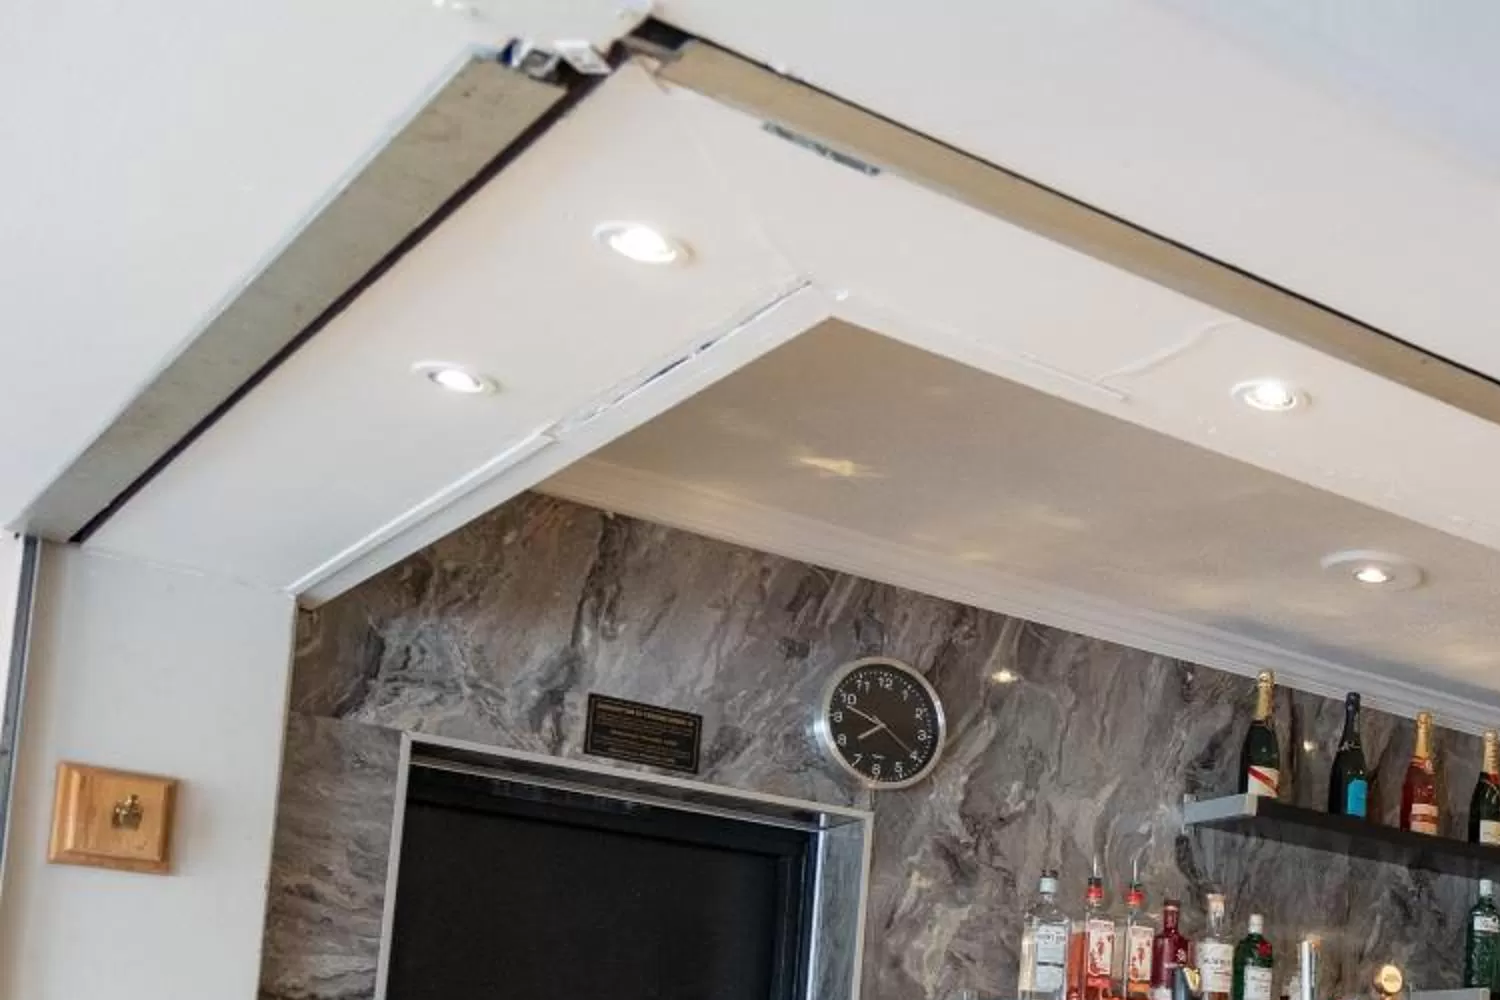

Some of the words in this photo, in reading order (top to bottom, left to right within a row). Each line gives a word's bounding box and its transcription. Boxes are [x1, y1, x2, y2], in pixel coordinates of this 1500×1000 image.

[878, 677, 893, 690] 12
[841, 693, 857, 705] 10
[917, 729, 927, 741] 3
[852, 753, 862, 767] 7
[871, 763, 881, 775] 6
[894, 761, 903, 773] 5
